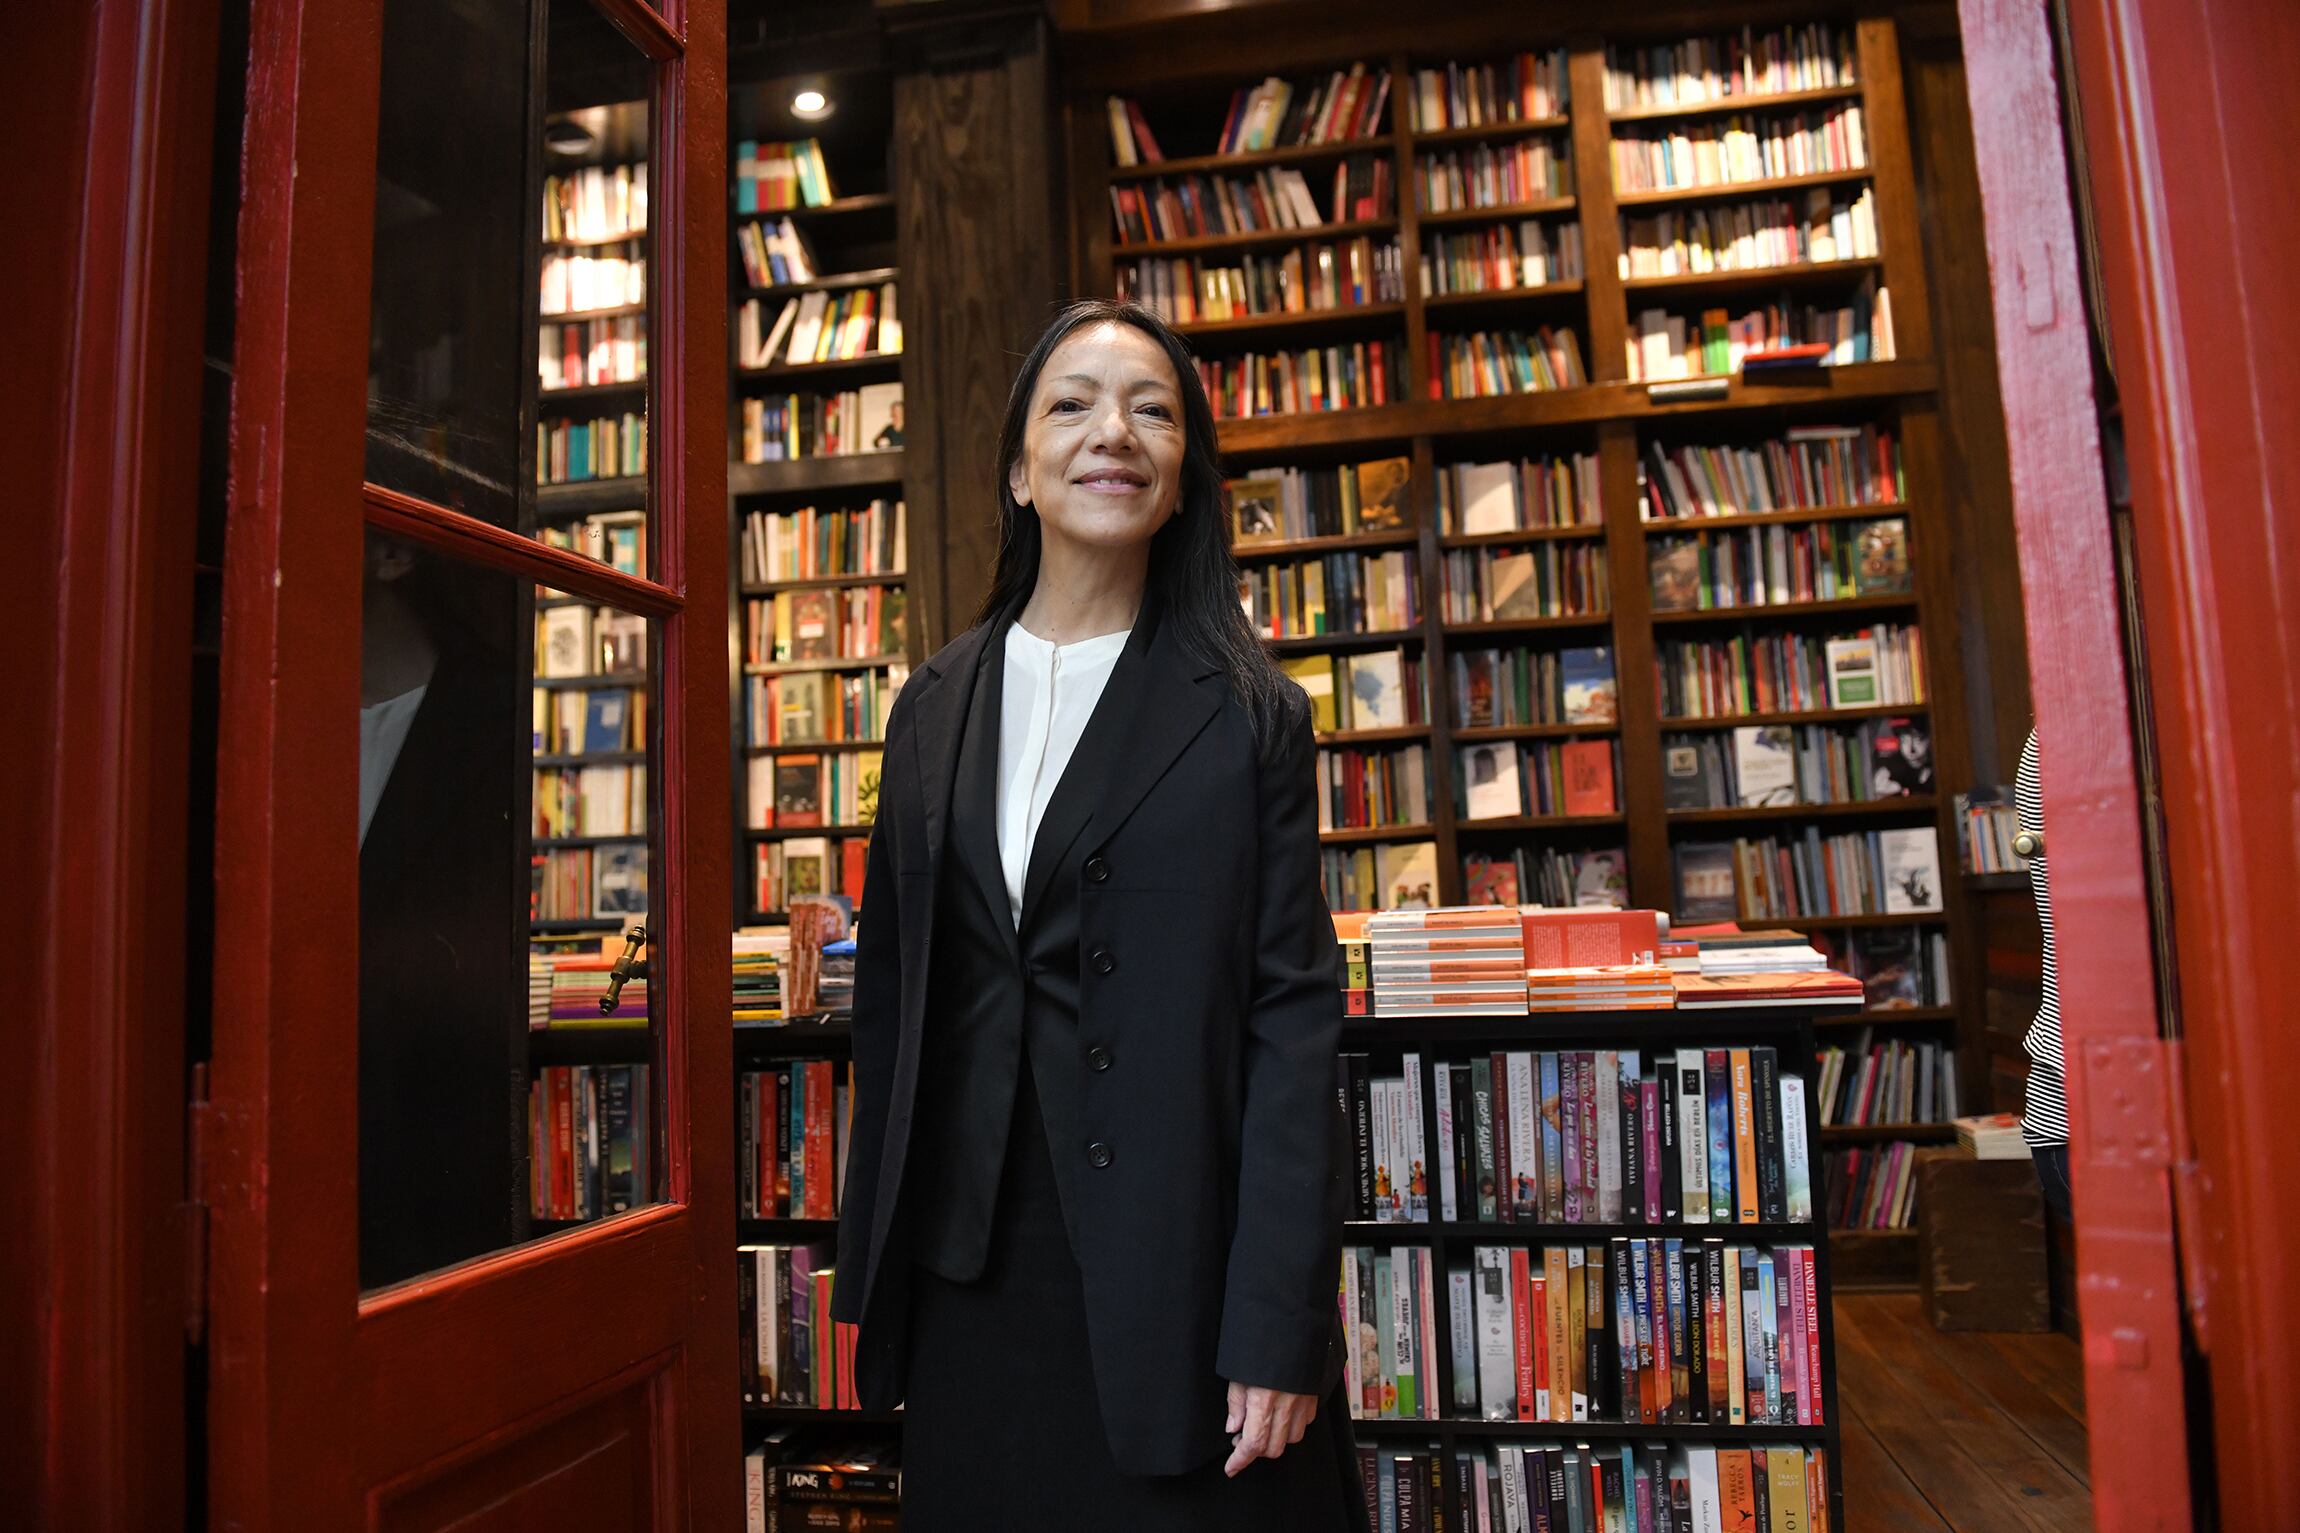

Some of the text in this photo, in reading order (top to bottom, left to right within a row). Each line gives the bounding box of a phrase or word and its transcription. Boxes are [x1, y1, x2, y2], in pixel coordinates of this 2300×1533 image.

[1563, 1062, 1572, 1098] RIVERO
[1580, 1061, 1589, 1097] RIVERO
[1735, 1063, 1746, 1088] Nora
[1475, 1091, 1491, 1124] CHICAS
[1519, 1064, 1531, 1162] ANA LENA RIVERA
[1566, 1102, 1575, 1112] Lo
[1737, 1091, 1749, 1136] Roberts
[1357, 1100, 1369, 1204] CARMEN MOLA EL INFIERNO
[1477, 1126, 1493, 1169] SALVAJES
[1627, 1113, 1636, 1185] VIVIANA RIVERO
[1617, 1250, 1627, 1289] WILBUR
[1652, 1250, 1661, 1284] WILBUR
[1669, 1250, 1680, 1280] WILBUR
[1690, 1263, 1698, 1291] WILBUR
[1709, 1250, 1720, 1284] WILBUR
[1619, 1286, 1630, 1313] SMITH
[1634, 1250, 1653, 1366] WILBUR SMITH LA PRESA DEL TIGRE
[1654, 1286, 1663, 1312] SMITH
[1670, 1280, 1682, 1304] SMITH
[1691, 1293, 1699, 1318] SMITH
[1710, 1285, 1721, 1313] SMITH
[1792, 1263, 1805, 1336] DANIELLE STEEL
[1401, 1298, 1409, 1326] JUEVES
[1518, 1314, 1528, 1358] cocineras
[1674, 1332, 1683, 1356] GUERRA
[1805, 1261, 1821, 1398] DANIELLE STEEL Beauchamp Hall
[1693, 1340, 1701, 1374] DORADO
[1520, 1366, 1531, 1399] Fenley
[1557, 1356, 1565, 1395] SILENCIO
[1770, 1390, 1776, 1398] EL
[749, 1472, 761, 1520] KING
[791, 1472, 819, 1489] KING
[1366, 1458, 1377, 1508] LUCINDA
[1380, 1475, 1393, 1503] CULPA
[1504, 1465, 1515, 1508] ROJAVA
[1729, 1465, 1737, 1505] REBECCA
[1398, 1478, 1411, 1529] CULPA MÍA
[1681, 1521, 1690, 1531] La
